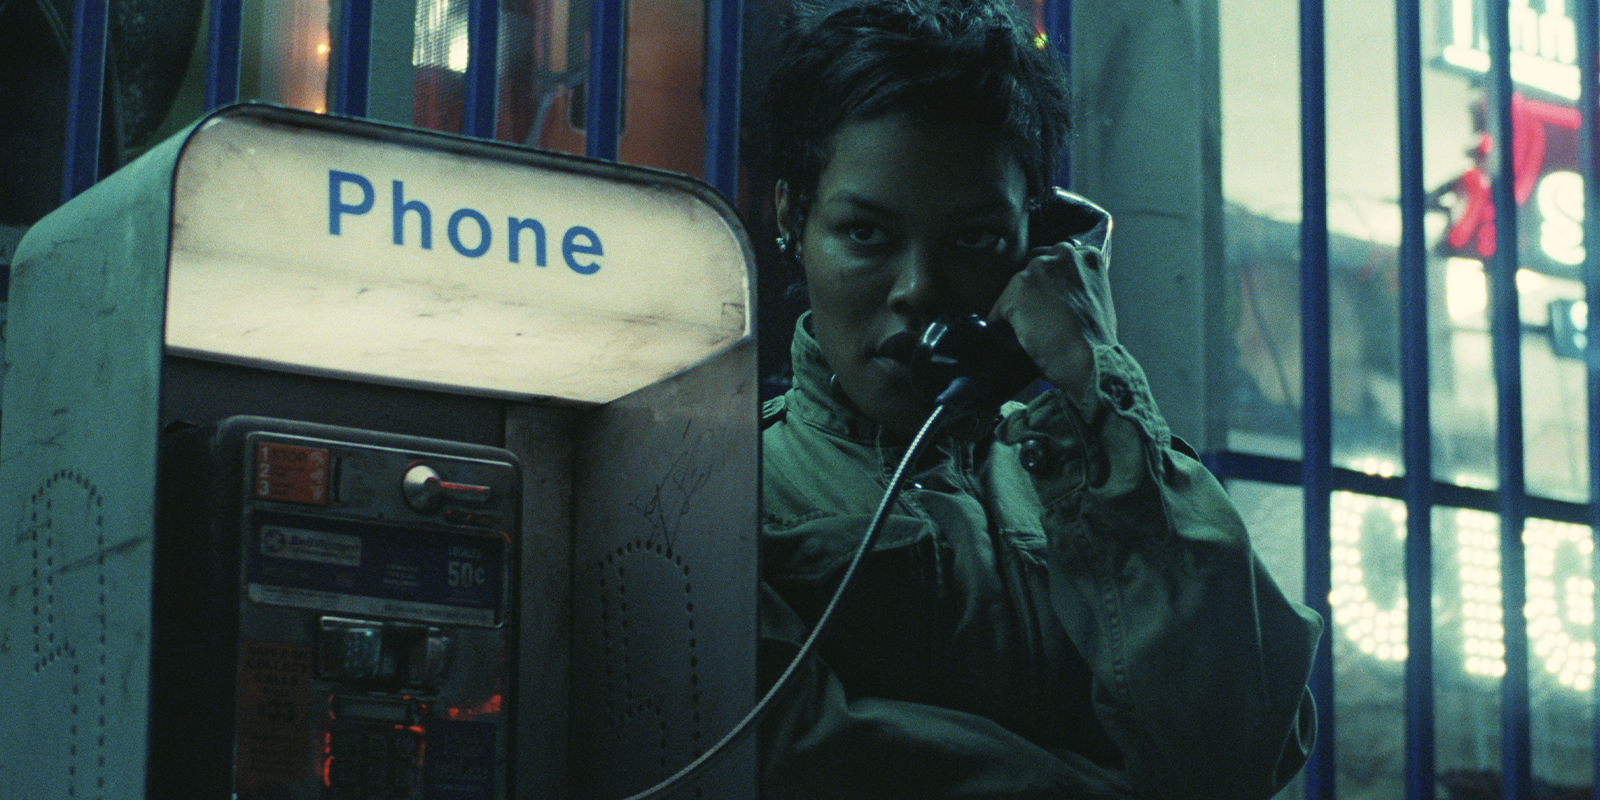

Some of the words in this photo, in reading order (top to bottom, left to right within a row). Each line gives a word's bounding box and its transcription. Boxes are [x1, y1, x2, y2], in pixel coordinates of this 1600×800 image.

[328, 169, 604, 275] Phone
[261, 446, 269, 461] 1
[258, 462, 271, 478] 2
[257, 480, 271, 496] 3
[447, 560, 486, 588] 50¢
